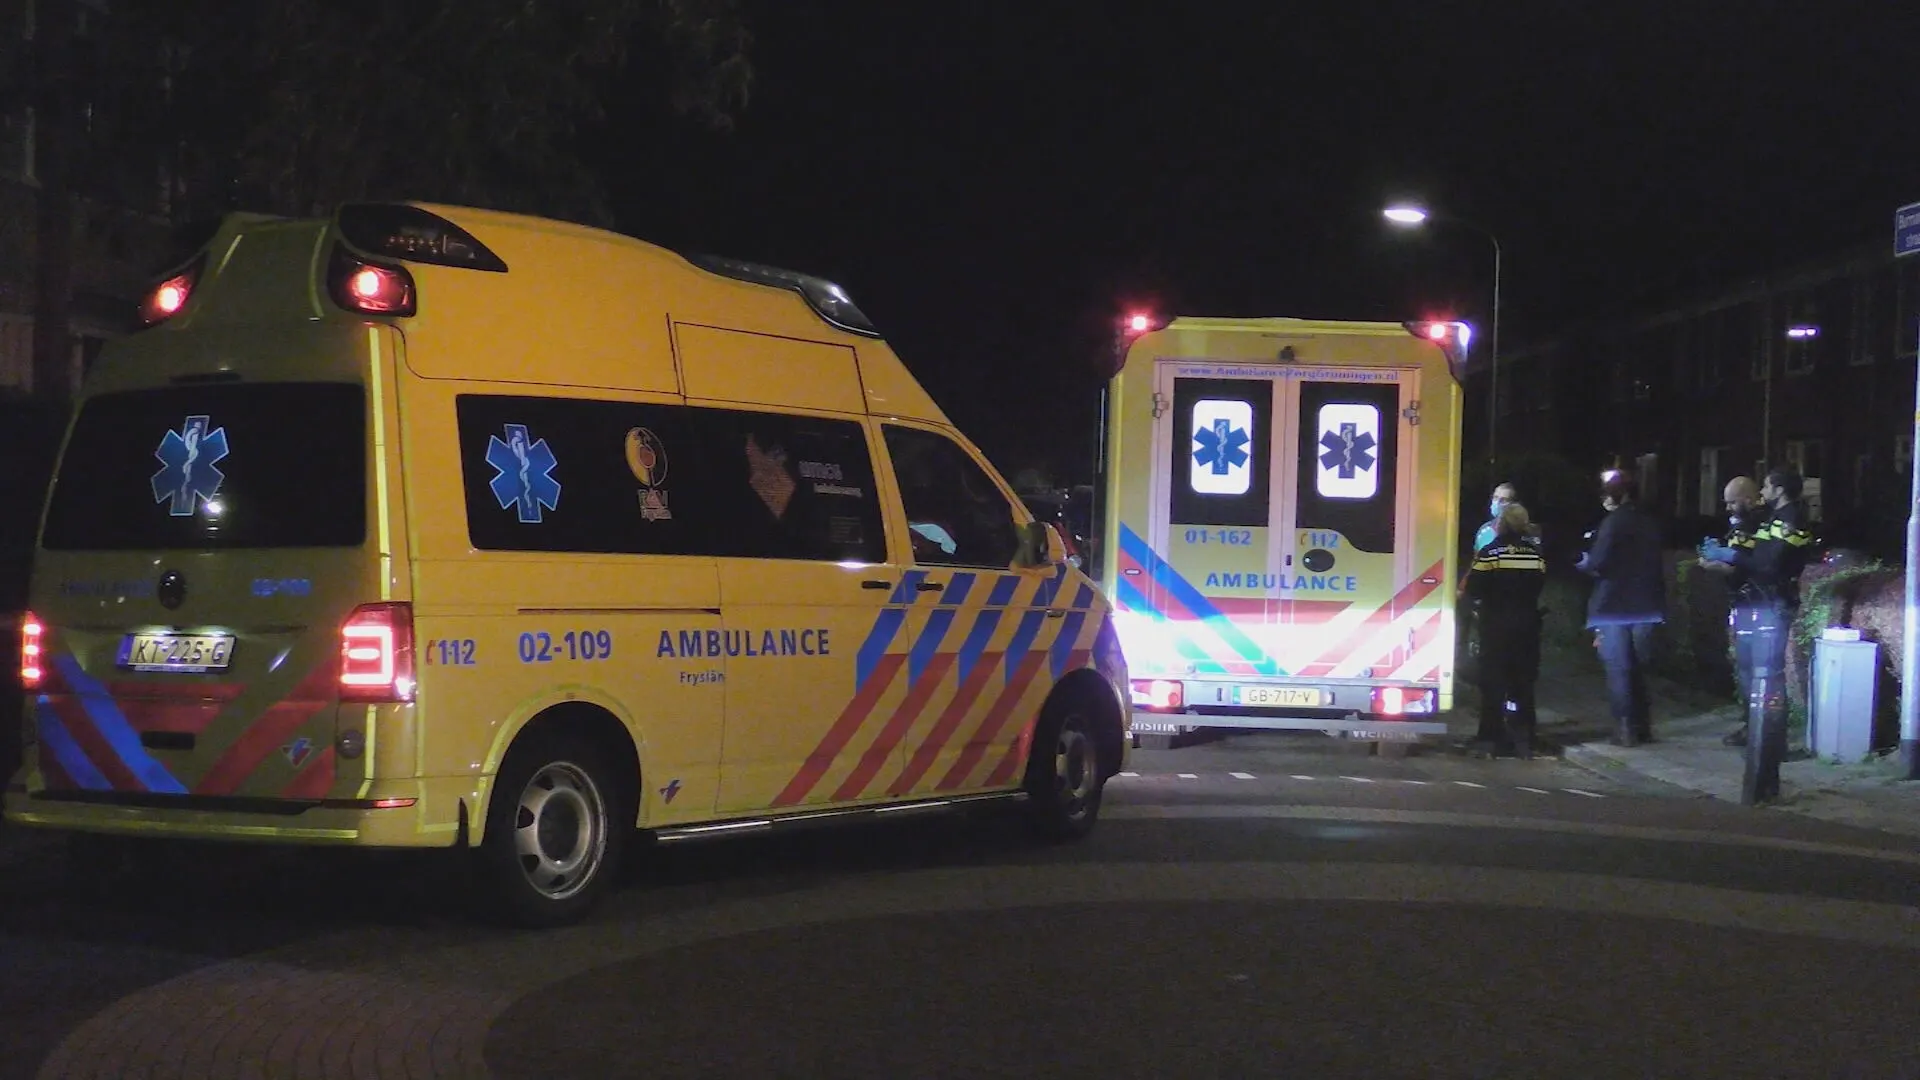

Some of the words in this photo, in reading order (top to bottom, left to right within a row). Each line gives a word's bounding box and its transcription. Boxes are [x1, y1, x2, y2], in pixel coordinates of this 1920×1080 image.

[1185, 528, 1252, 546] 01-162
[1206, 573, 1357, 591] AMBULANCE
[136, 640, 225, 664] KT-225-G
[518, 630, 612, 663] 02-109
[657, 629, 830, 658] AMBULANCE
[1248, 689, 1311, 703] GB-717-V
